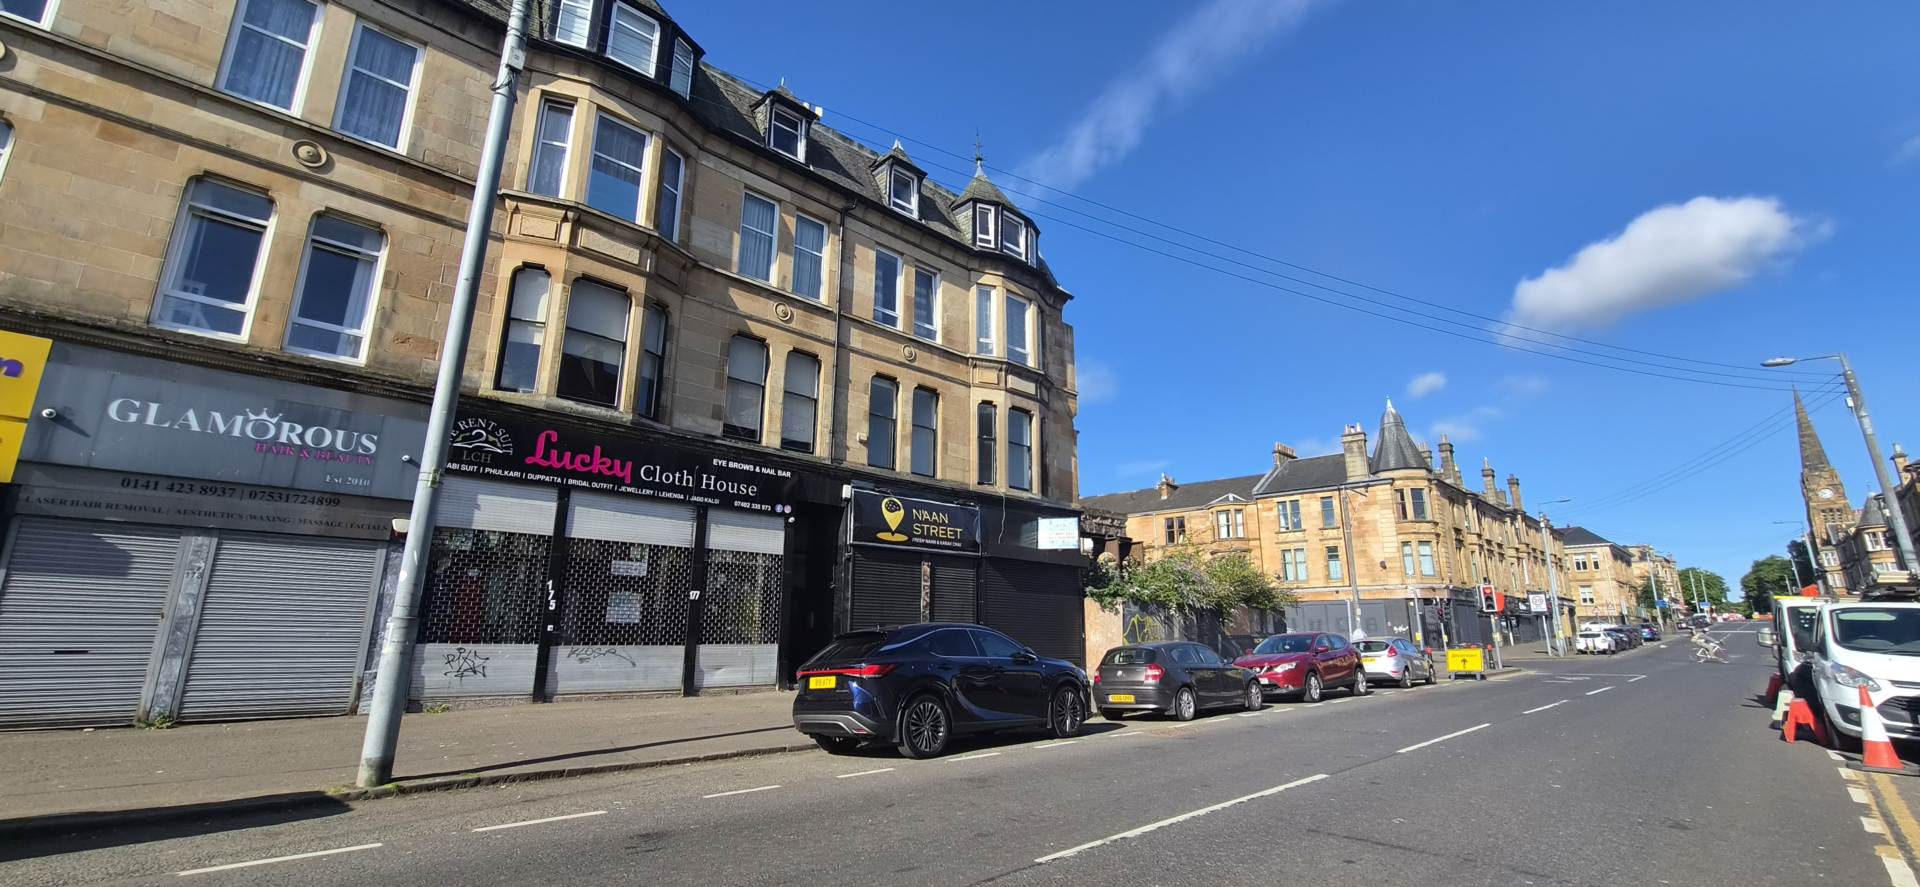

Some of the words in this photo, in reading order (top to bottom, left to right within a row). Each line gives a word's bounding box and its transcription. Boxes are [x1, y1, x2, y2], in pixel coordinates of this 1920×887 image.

[107, 398, 378, 454] GLAMOROUS
[457, 417, 497, 431] RENT
[495, 427, 513, 456] SUIT
[255, 442, 295, 456] HAIR
[315, 450, 374, 465] BEAUTY
[463, 450, 492, 464] LCH
[525, 430, 632, 484] Lucky
[640, 464, 693, 488] Cloth
[700, 473, 757, 497] House
[713, 458, 728, 467] EYE
[728, 460, 754, 472] BROWS
[761, 467, 776, 476] NAIL
[777, 469, 792, 478] BAR
[121, 477, 159, 490] 0141
[166, 482, 194, 494] 423
[200, 485, 237, 498] 8937
[249, 490, 340, 507] 07531724899
[346, 476, 371, 486] 2010
[445, 462, 460, 470] ABI
[460, 463, 478, 473] SUIT
[484, 467, 521, 478] PHULKARI
[527, 473, 562, 484] DUPPATTA
[567, 478, 590, 488] BRIDAL
[591, 481, 614, 491] OUTFIT
[618, 485, 654, 496] JEWELLERY
[658, 491, 684, 500] LEHENGA
[25, 495, 70, 506] LASER
[70, 500, 101, 509] HAIR
[104, 502, 165, 514] REMOVAL
[176, 509, 244, 520] AESTHETICS
[299, 517, 343, 528] MASSAGE
[350, 522, 388, 531] FACIALS
[913, 522, 963, 540] STREET
[546, 579, 556, 611] 175
